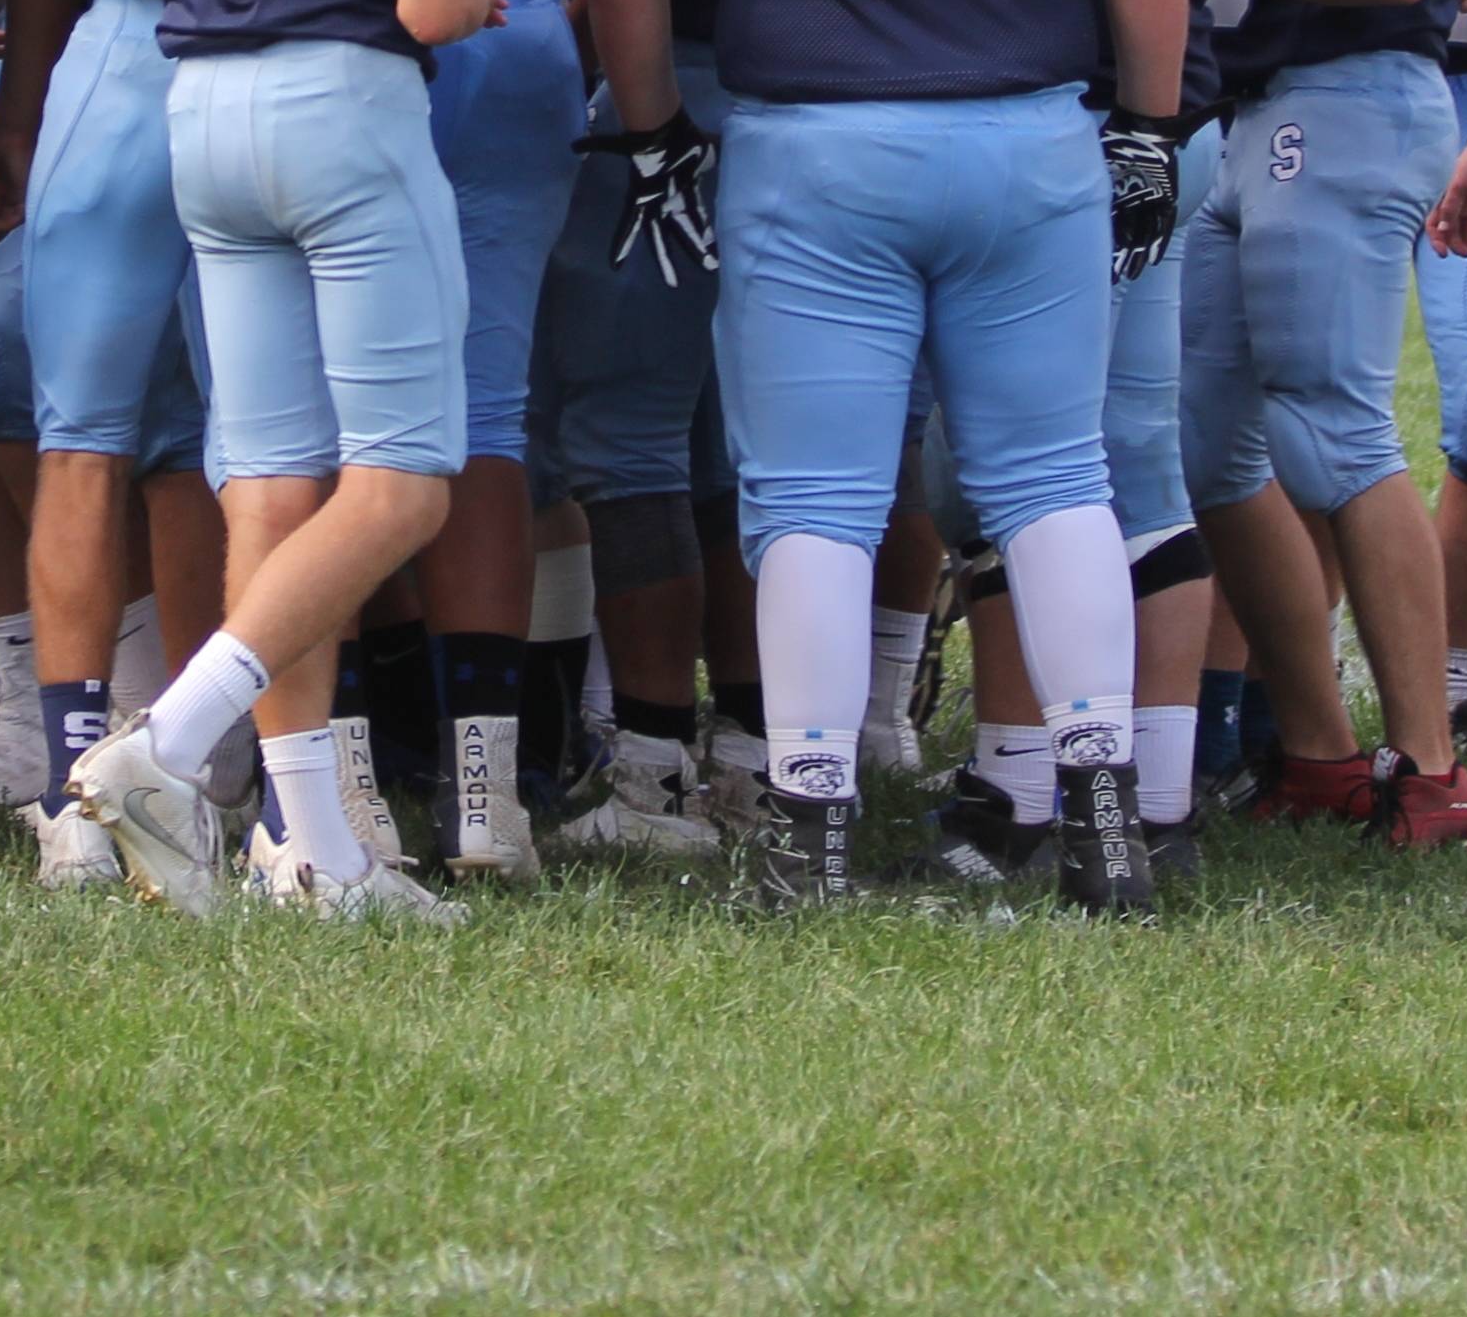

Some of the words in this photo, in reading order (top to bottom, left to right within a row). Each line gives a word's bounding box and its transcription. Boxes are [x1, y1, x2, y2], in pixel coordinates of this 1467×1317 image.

[1267, 123, 1305, 182] S
[63, 710, 108, 749] S
[462, 723, 488, 828] ARMOUR
[1090, 770, 1132, 880] ARMOUR
